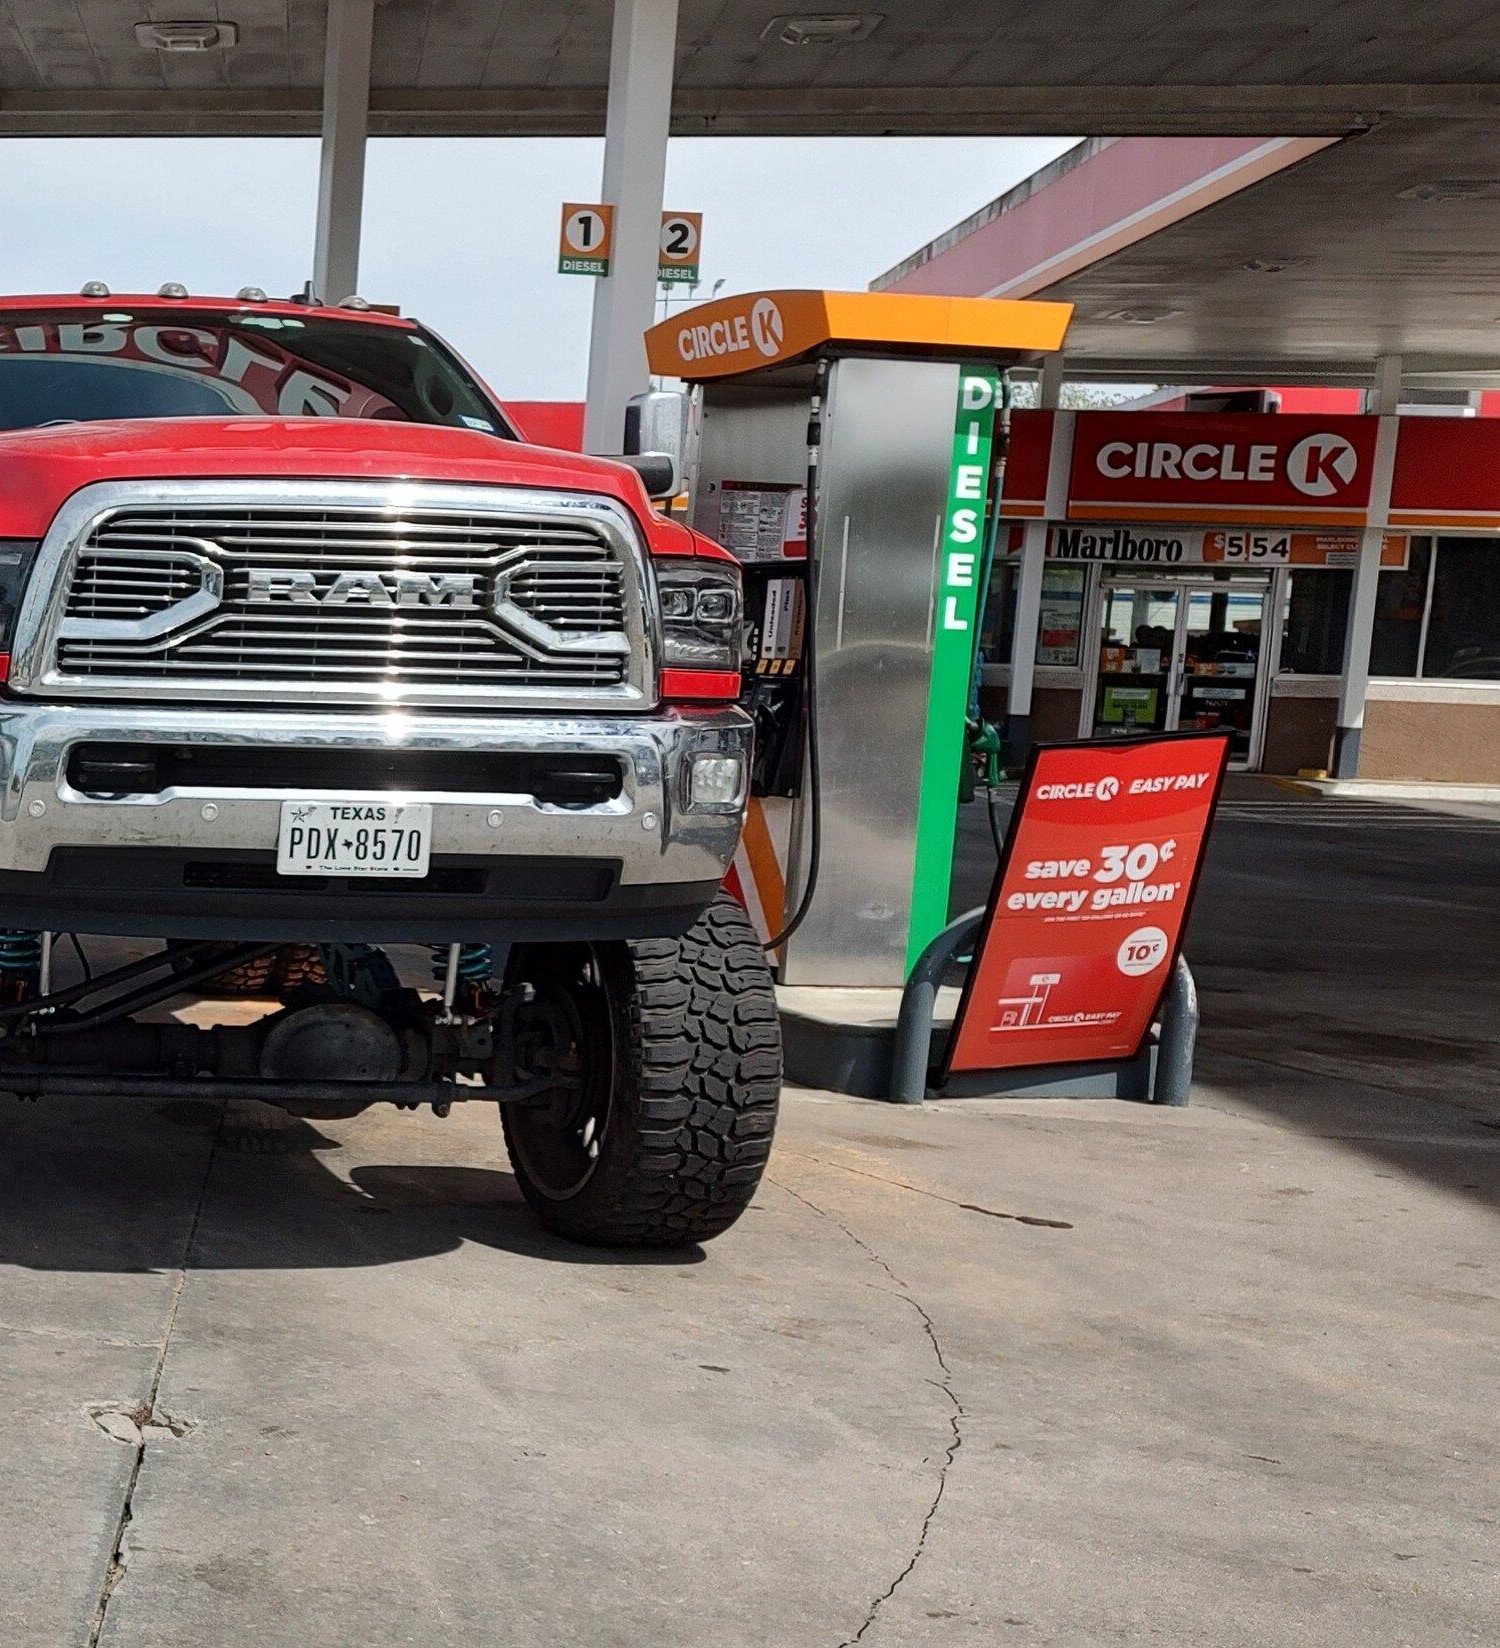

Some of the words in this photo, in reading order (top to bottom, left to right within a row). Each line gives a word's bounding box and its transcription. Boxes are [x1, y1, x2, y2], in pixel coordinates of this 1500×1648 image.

[578, 216, 592, 247] 1
[666, 223, 690, 254] 2
[562, 260, 605, 273] DIESEL
[678, 316, 750, 361] CIRCLE
[754, 302, 783, 356] K
[1096, 441, 1278, 481] CIRCLE
[1294, 438, 1353, 496] K
[943, 376, 992, 631] DIESEL
[1055, 528, 1183, 563] Marlboro
[249, 569, 474, 606] RAM
[1037, 782, 1095, 800] CIRCLE
[1096, 776, 1119, 801] K
[1129, 775, 1176, 794] EASY
[1174, 773, 1210, 791] PAY
[330, 807, 386, 821] TEXAS
[1025, 858, 1091, 880] save
[1093, 839, 1177, 883] 30¢
[1006, 888, 1088, 912] every
